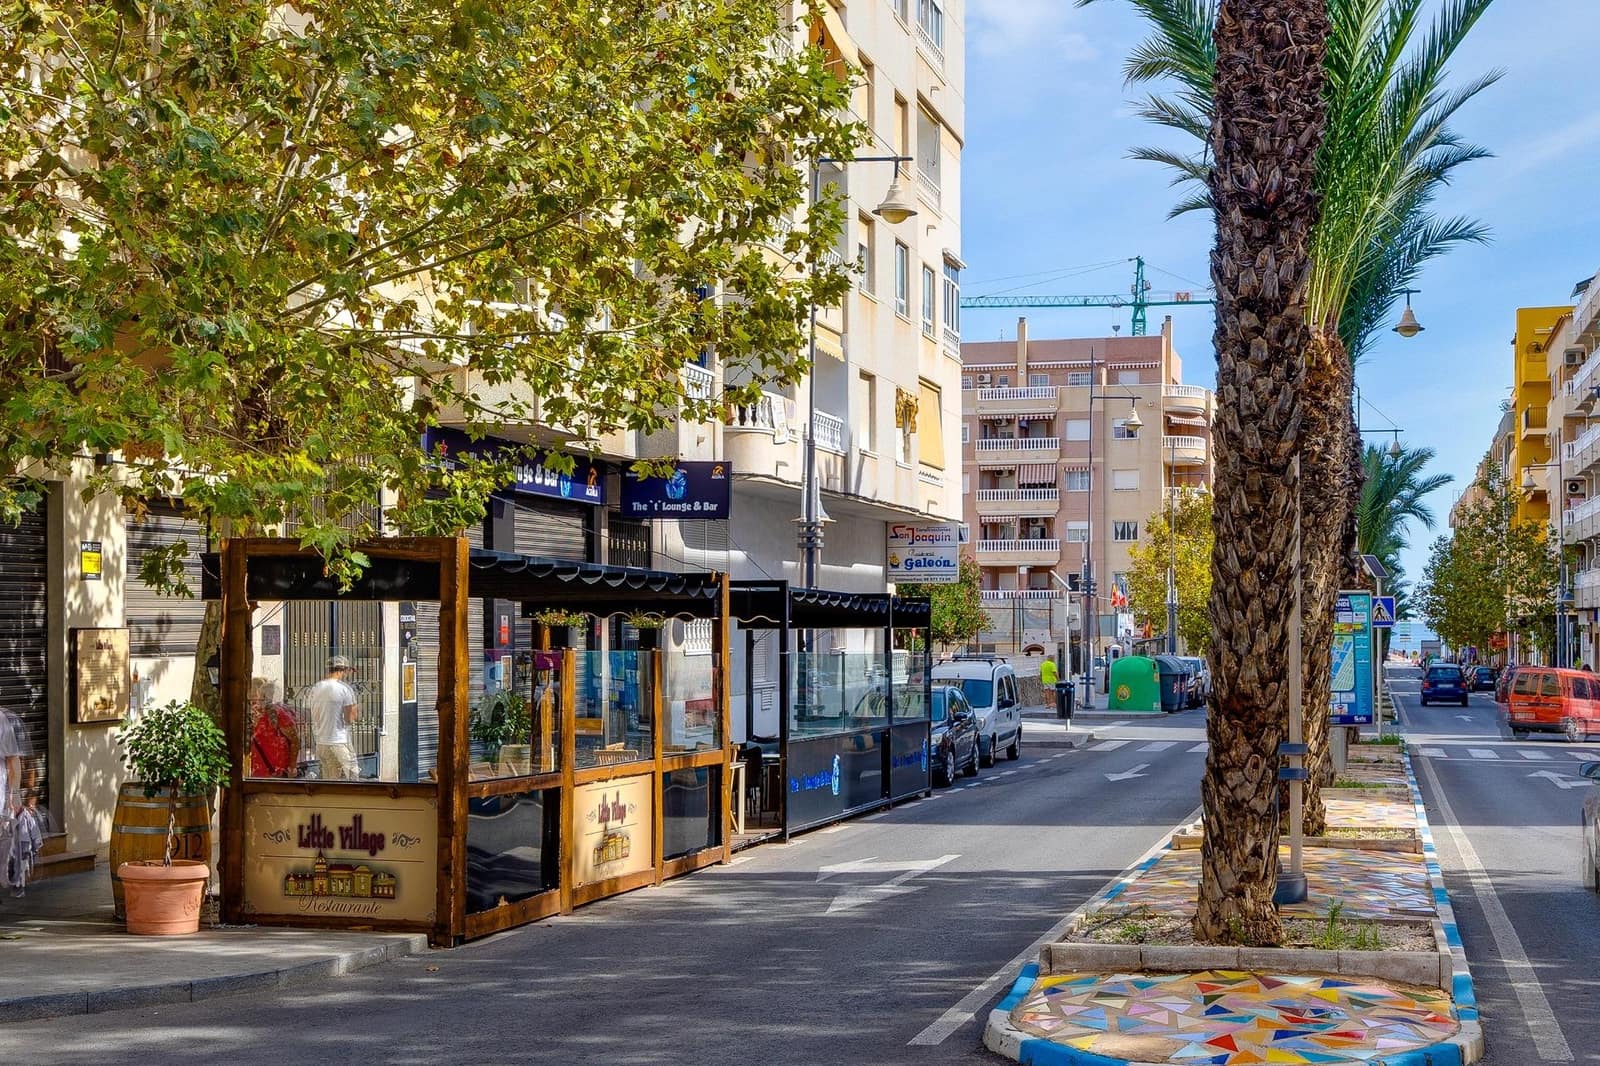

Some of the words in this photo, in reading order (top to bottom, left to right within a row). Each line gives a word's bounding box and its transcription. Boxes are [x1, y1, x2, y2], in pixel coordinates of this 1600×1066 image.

[632, 501, 648, 511] The
[662, 501, 692, 512] Lounge
[693, 500, 702, 511] &
[703, 501, 718, 511] Bar
[298, 813, 335, 849] Little
[338, 813, 386, 857] Village
[298, 896, 383, 914] Restaurante
